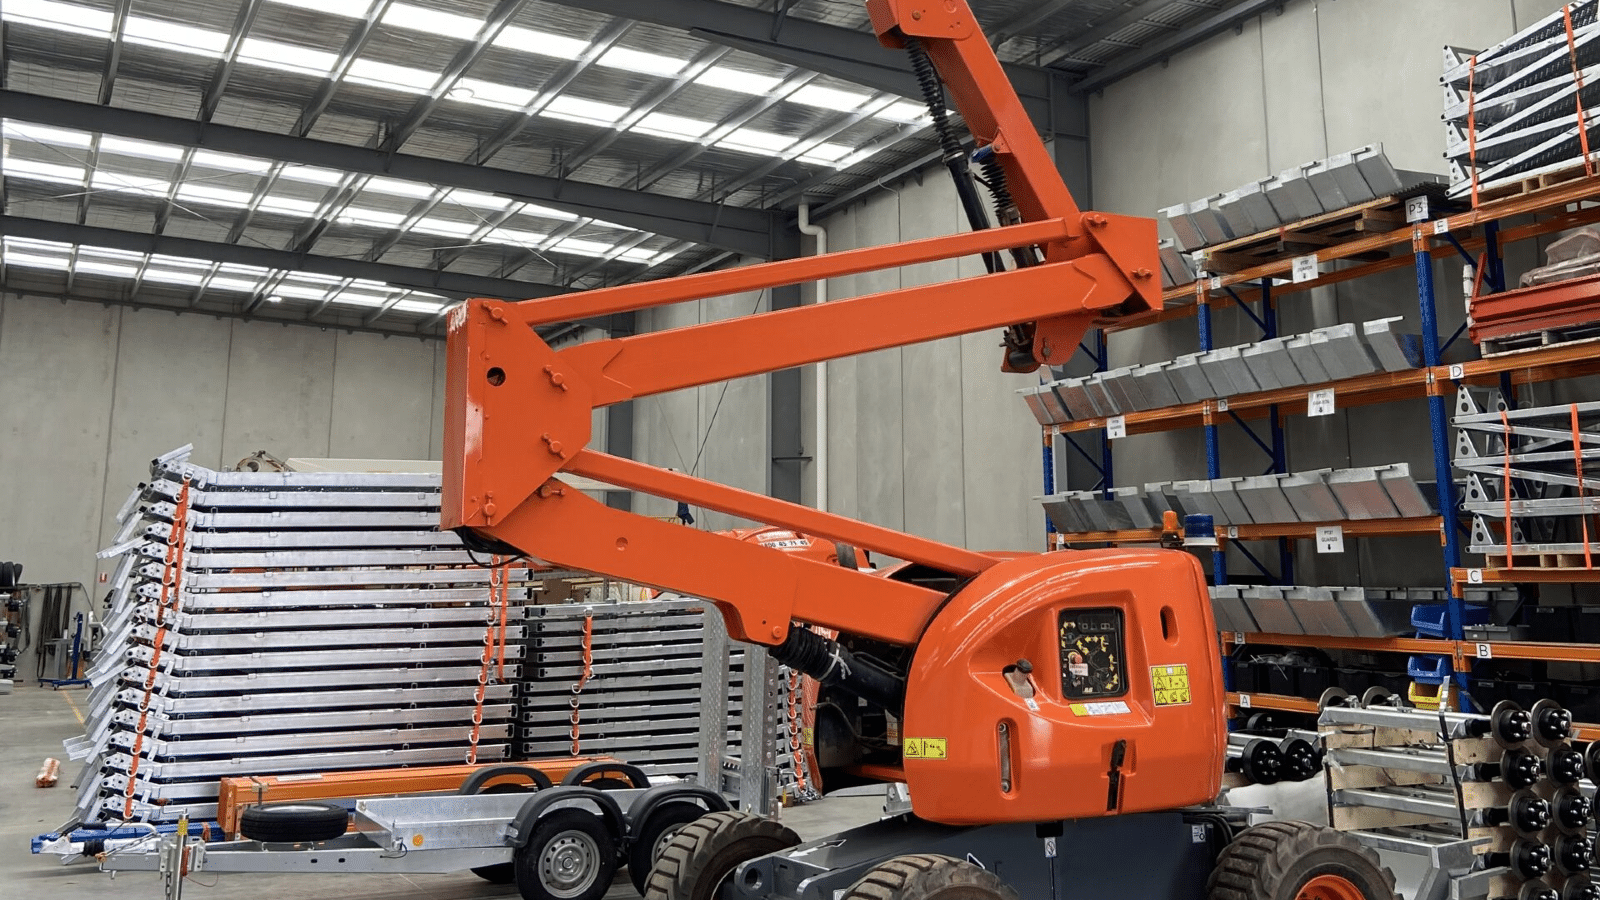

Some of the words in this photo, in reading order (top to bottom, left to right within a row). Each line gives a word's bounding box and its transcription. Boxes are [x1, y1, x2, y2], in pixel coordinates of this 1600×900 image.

[1409, 202, 1423, 215] P3
[1453, 366, 1462, 377] D
[1230, 527, 1237, 537] C
[1471, 570, 1479, 582] C
[1237, 632, 1243, 642] B
[1479, 645, 1488, 656] B
[1242, 695, 1249, 706] A
